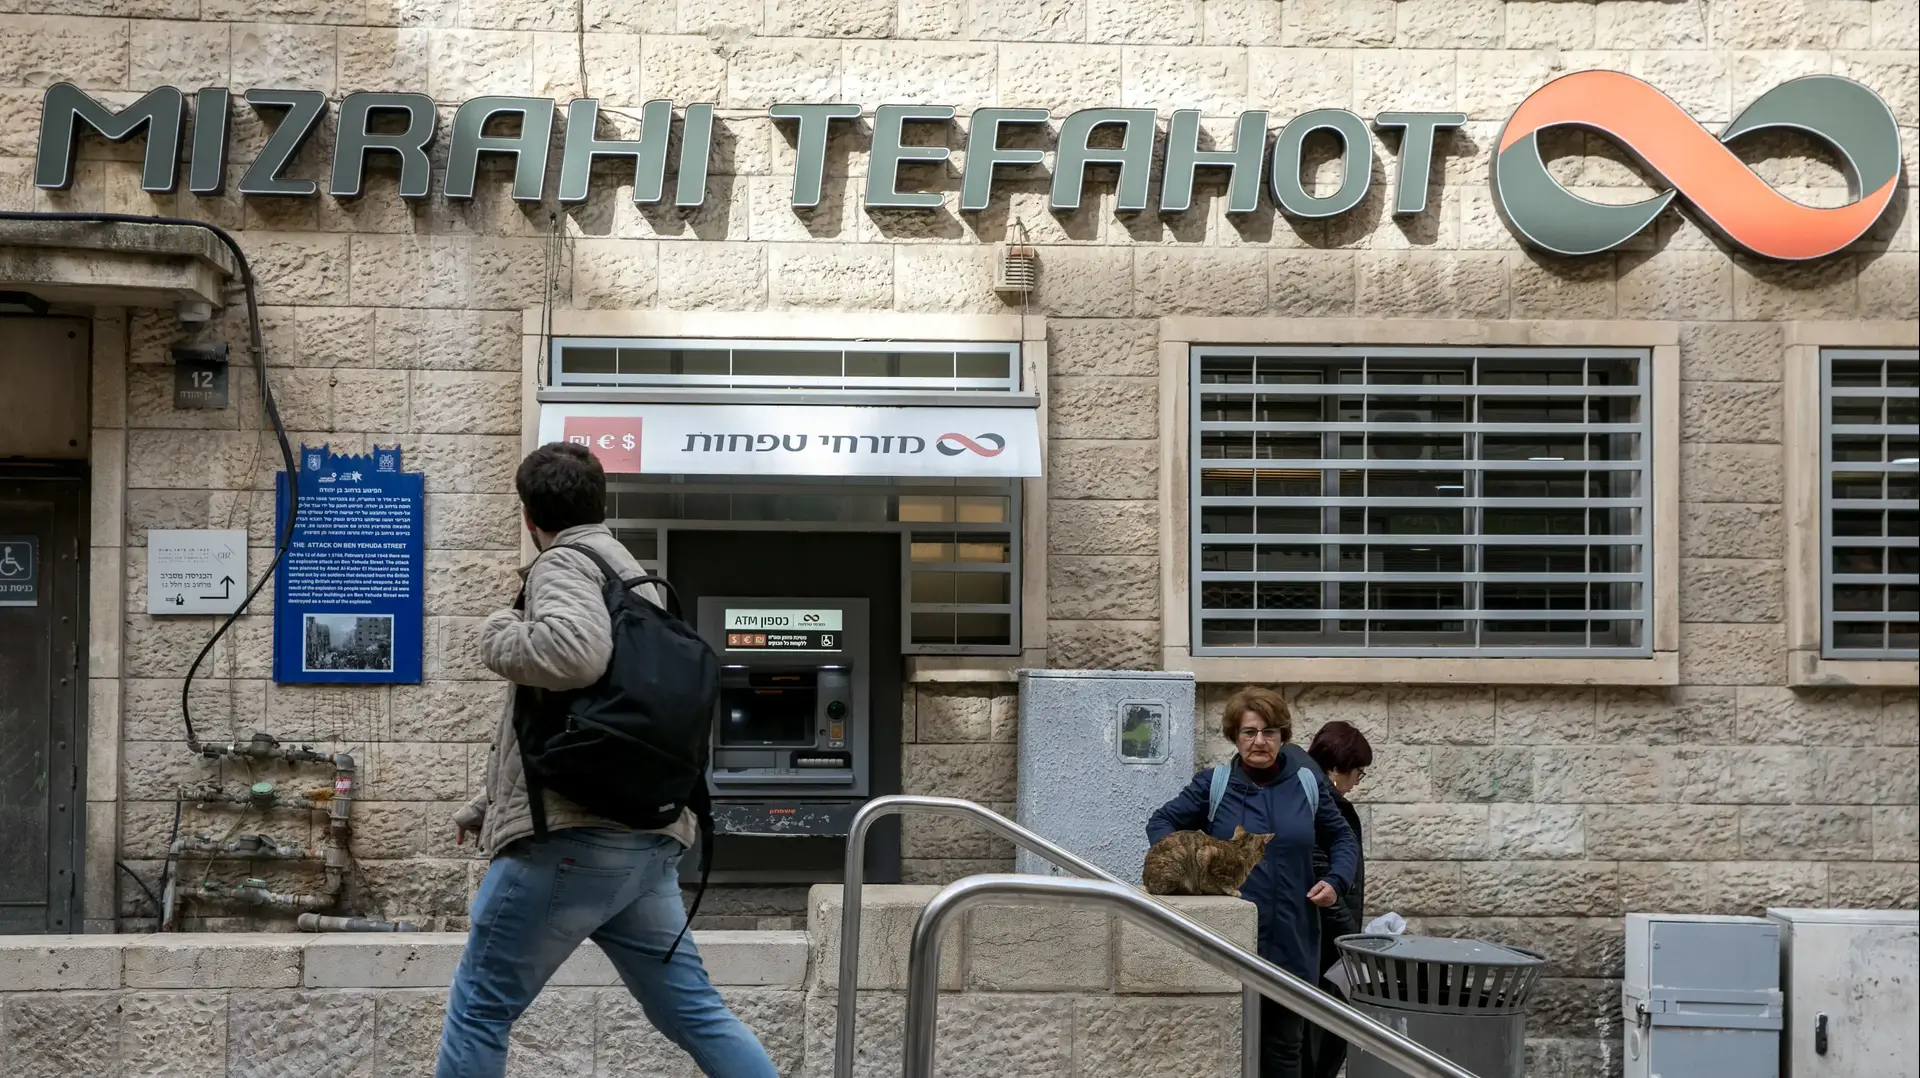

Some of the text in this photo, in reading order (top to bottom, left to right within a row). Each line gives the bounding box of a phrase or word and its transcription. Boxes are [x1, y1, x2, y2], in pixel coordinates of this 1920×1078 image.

[33, 81, 1468, 219] MIZRAHI TEFAHOT
[191, 371, 213, 388] 12
[180, 390, 203, 399] יהודה
[596, 434, 615, 450] €
[622, 432, 636, 451] $
[681, 433, 926, 454] מזרחי טפחות
[734, 616, 789, 628] כספון ATM
